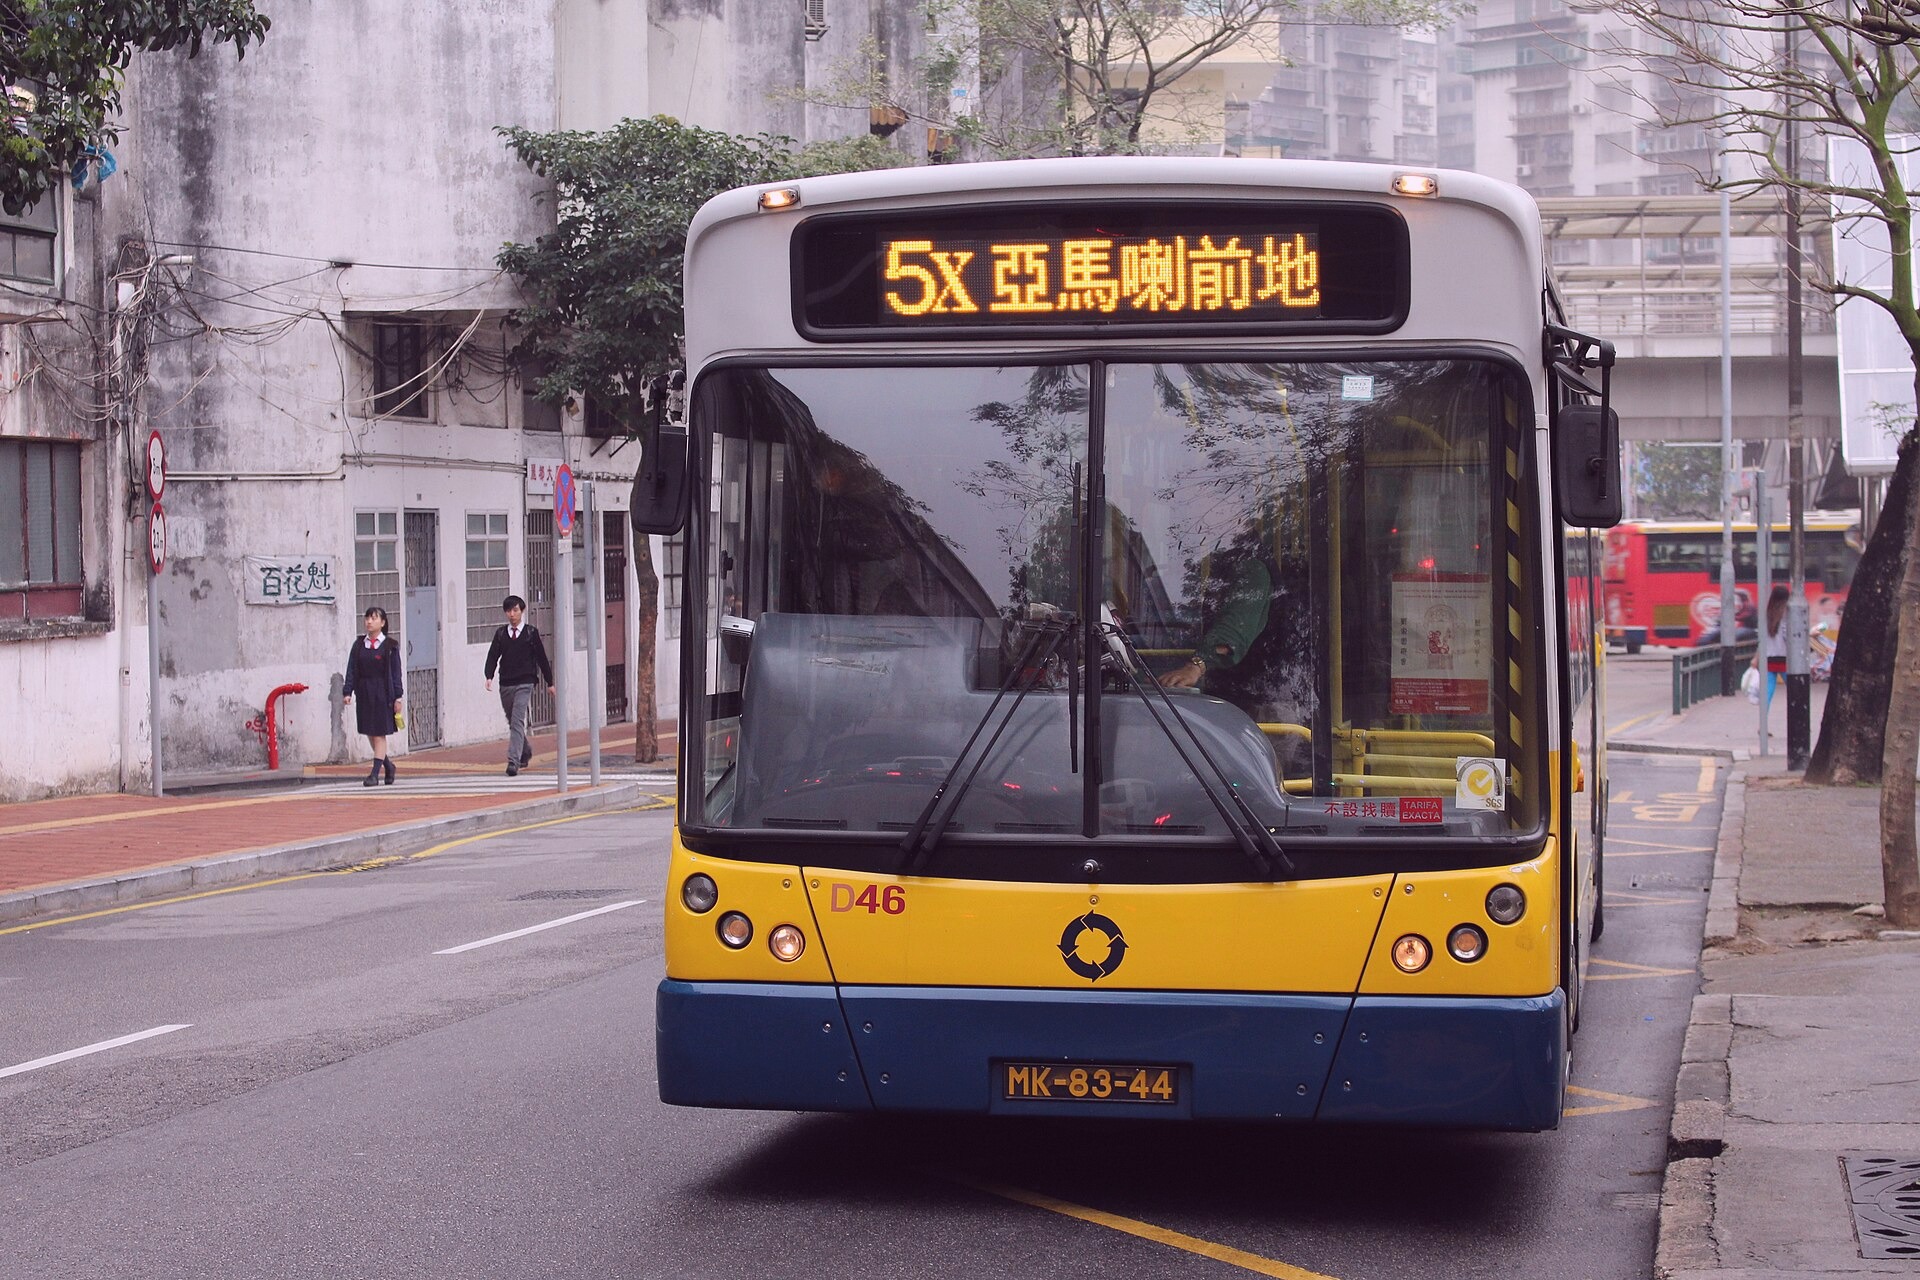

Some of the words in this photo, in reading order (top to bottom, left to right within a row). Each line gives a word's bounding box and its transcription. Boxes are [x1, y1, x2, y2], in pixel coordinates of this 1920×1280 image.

[886, 240, 979, 314] 5X
[989, 234, 1320, 312] 亞馬喇前地
[260, 562, 331, 596] 百花魁
[1324, 802, 1396, 818] 不設找贖
[1404, 801, 1439, 810] TARIFA
[1485, 797, 1502, 809] SGS
[1401, 811, 1441, 820] EXACTA
[831, 883, 906, 915] D46
[1008, 1066, 1173, 1100] MK-83-44
